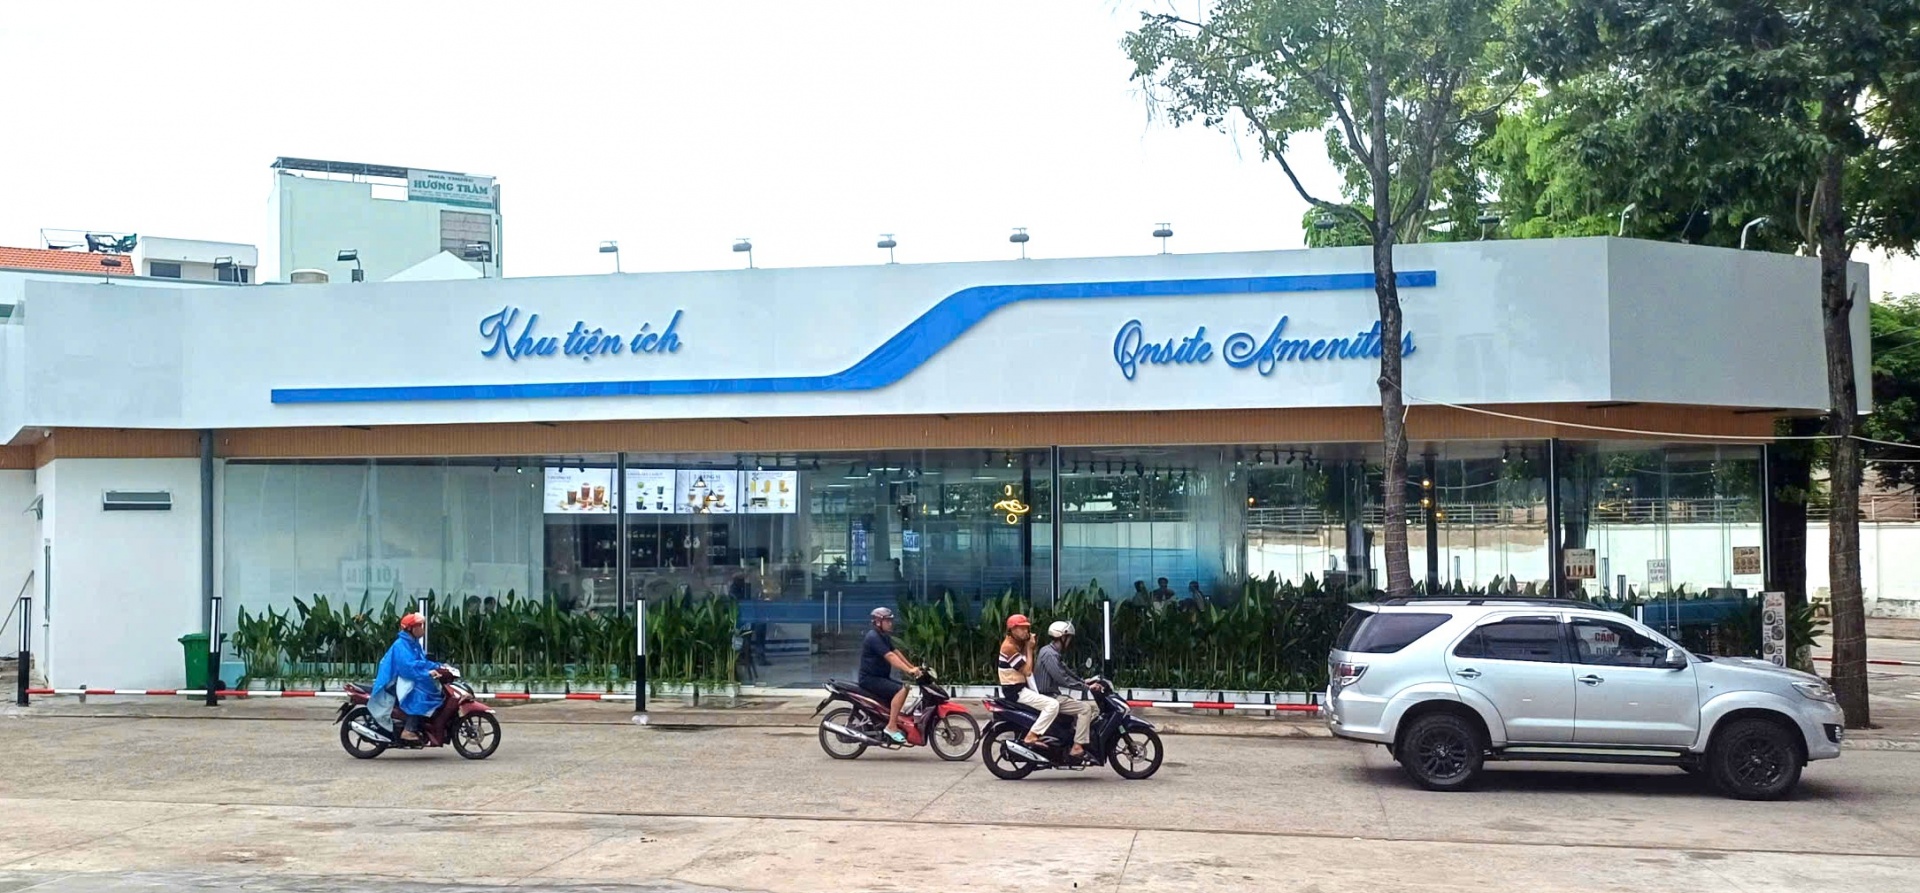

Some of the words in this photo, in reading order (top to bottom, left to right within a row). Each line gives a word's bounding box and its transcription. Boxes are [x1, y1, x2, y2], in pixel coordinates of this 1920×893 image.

[413, 179, 454, 191] HƯƠNG
[479, 305, 559, 362] Khu
[563, 320, 623, 362] tiện
[630, 308, 684, 354] ích
[1113, 318, 1213, 380] Onsite
